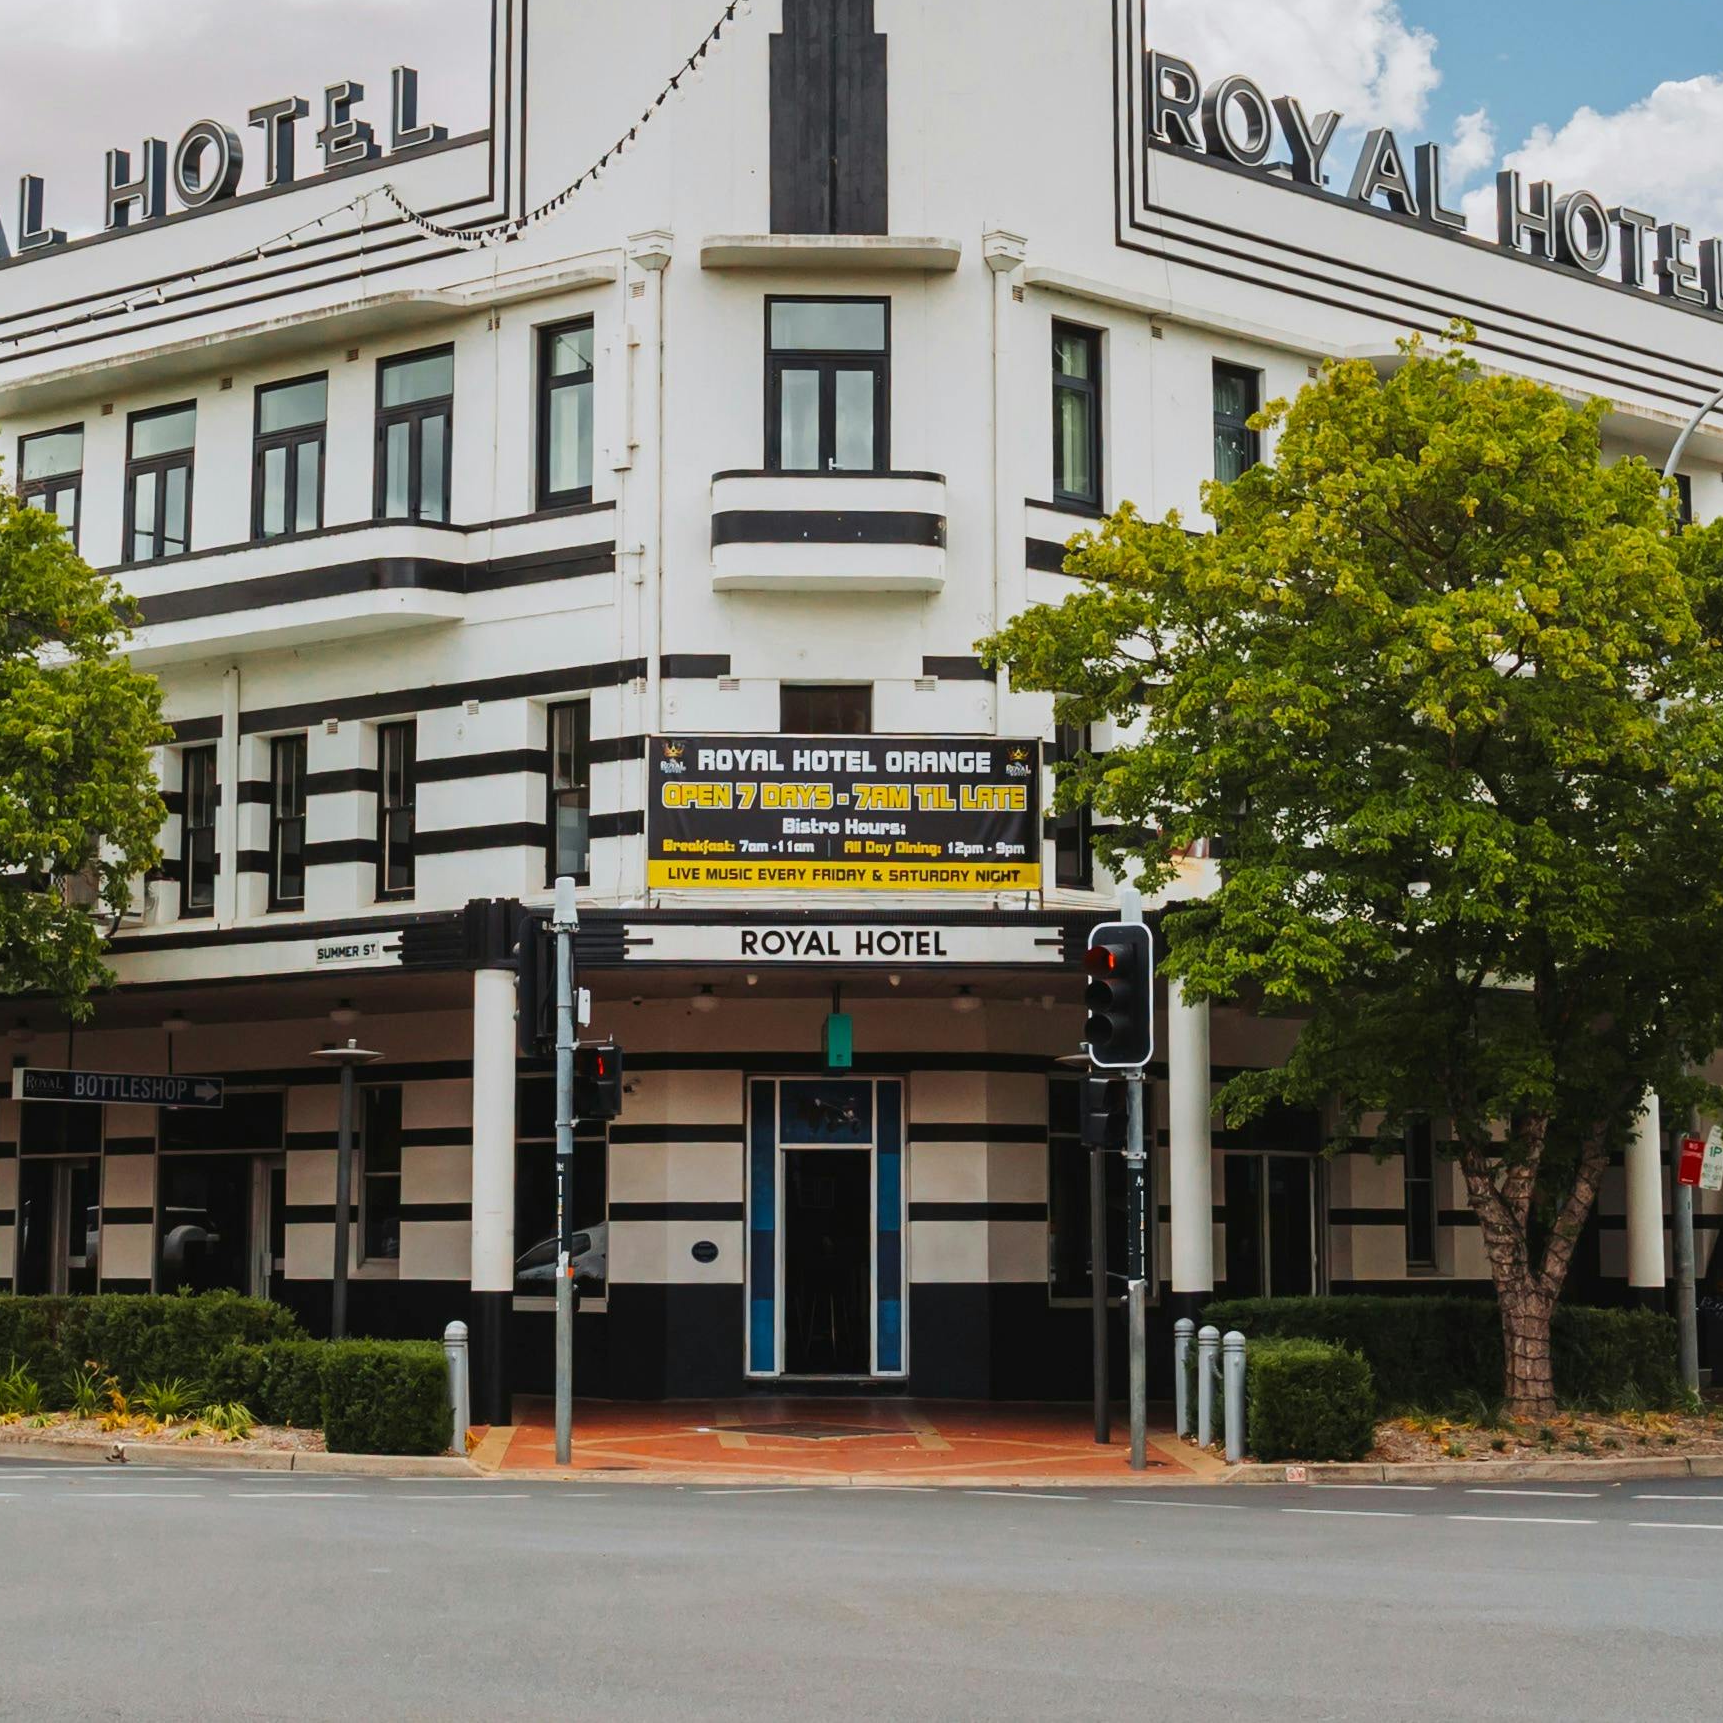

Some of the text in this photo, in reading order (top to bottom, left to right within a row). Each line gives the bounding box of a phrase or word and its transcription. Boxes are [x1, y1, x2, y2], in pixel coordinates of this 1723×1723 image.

[104, 65, 448, 230] HOTEL
[1145, 49, 1467, 231] ROYAL
[698, 749, 991, 773] ROYAL HOTEL ORANGE
[662, 782, 733, 809] OPEN
[736, 782, 757, 809] 7
[761, 782, 833, 810] DAYS
[852, 783, 911, 810] 7AM
[914, 784, 956, 811] TIL
[960, 784, 1027, 811] LATE
[782, 817, 906, 835] Bistro Hours:
[663, 839, 735, 854] Breakfast:
[739, 839, 769, 852] 7am
[844, 841, 861, 853] All
[866, 841, 892, 857] Day
[895, 841, 942, 857] Dining:
[947, 842, 984, 857] 12pm
[996, 842, 1025, 857] 9pm
[668, 867, 1021, 883] LIVE MUSIC EVERY FRIDAY & SATURDAY NIGHT
[317, 945, 359, 959] SUMMER
[741, 930, 947, 957] ROYAL HOTEL
[74, 1075, 188, 1100] BOTTLESHOP
